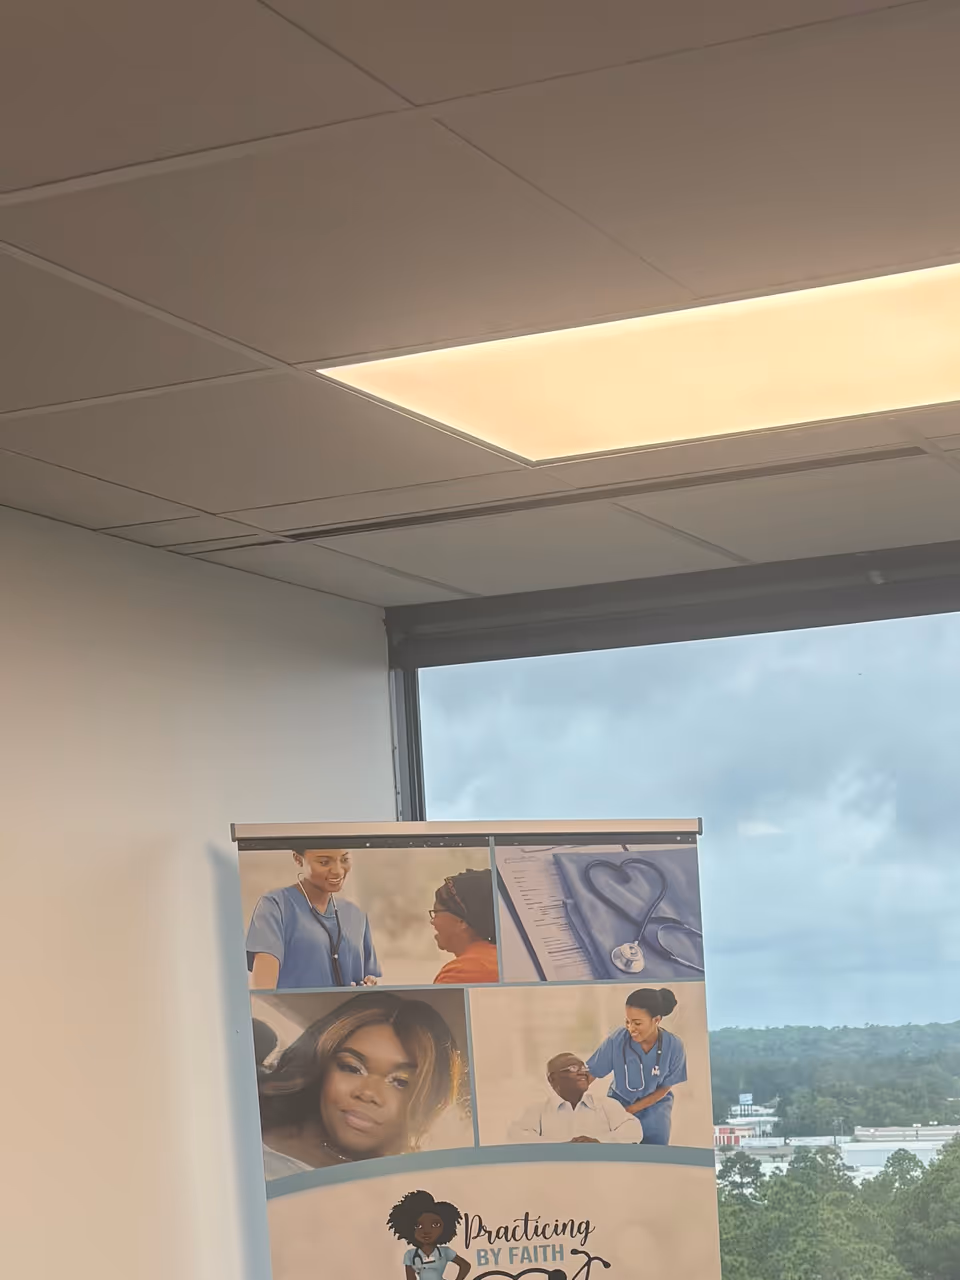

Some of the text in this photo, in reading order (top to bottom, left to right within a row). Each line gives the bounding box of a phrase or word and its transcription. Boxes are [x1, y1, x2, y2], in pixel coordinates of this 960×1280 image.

[464, 1211, 596, 1249] Practicing
[476, 1244, 565, 1266] BY FAITH
